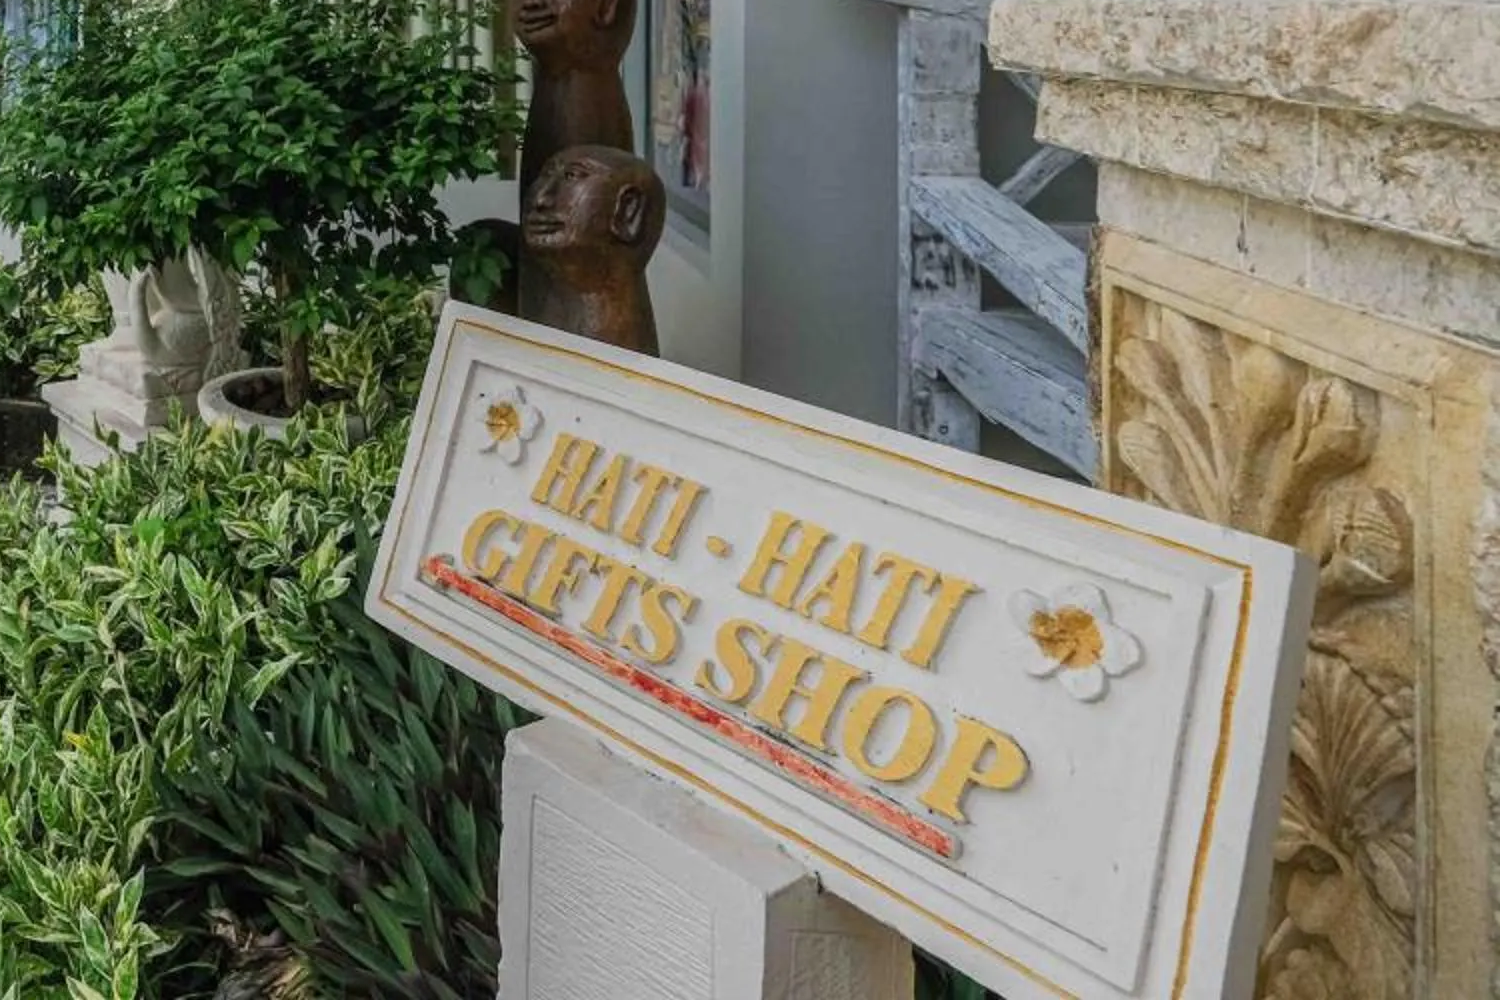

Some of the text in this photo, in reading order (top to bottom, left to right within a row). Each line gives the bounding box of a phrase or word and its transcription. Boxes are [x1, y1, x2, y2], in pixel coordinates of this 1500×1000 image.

[460, 508, 1029, 823] GIFTS SHOP
[531, 432, 706, 558] HATI
[738, 511, 980, 668] HATI
